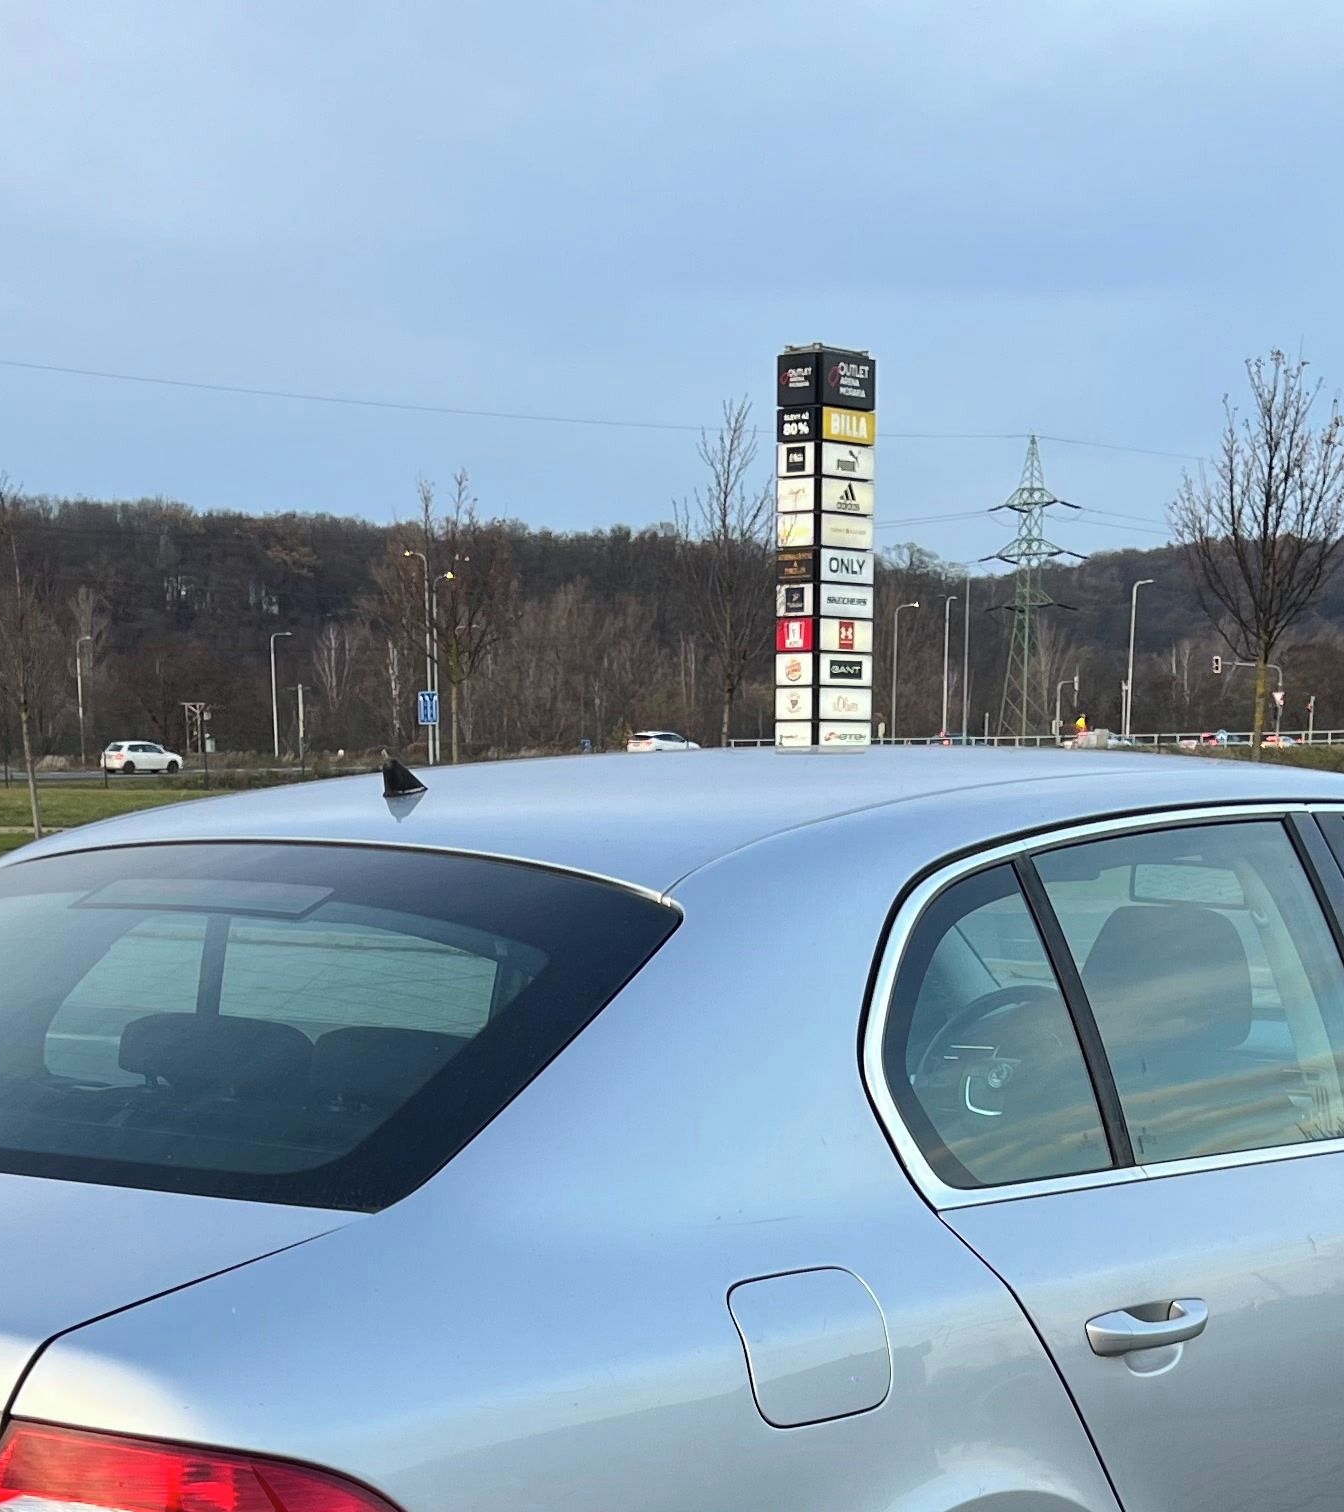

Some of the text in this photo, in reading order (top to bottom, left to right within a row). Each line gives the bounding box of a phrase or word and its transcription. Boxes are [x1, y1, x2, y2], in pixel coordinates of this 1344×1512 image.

[838, 362, 870, 379] OUTLET
[830, 412, 868, 439] BILLA
[829, 556, 866, 575] ONLY
[831, 665, 861, 674] GANT
